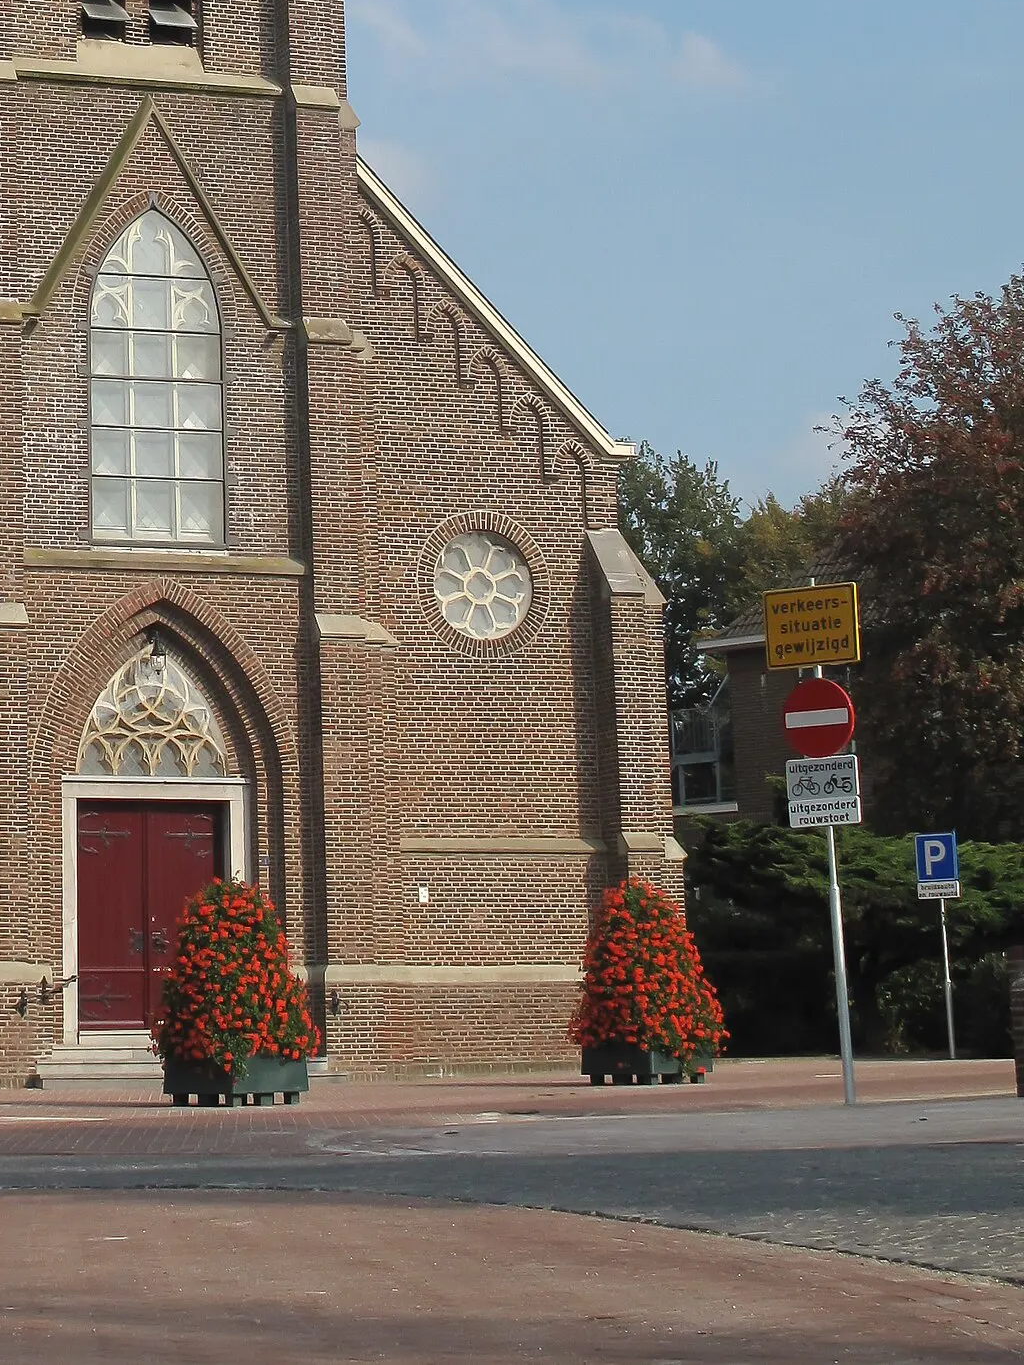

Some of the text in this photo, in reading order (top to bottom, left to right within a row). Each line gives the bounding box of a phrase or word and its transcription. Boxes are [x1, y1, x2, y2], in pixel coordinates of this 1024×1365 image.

[771, 597, 848, 615] verkeers-
[780, 616, 842, 634] situatie
[775, 634, 850, 660] gewijzigd
[789, 760, 853, 776] uitgezonderd
[790, 798, 857, 815] uitgezonderd
[799, 812, 850, 825] rouwstoet
[924, 840, 946, 876] P
